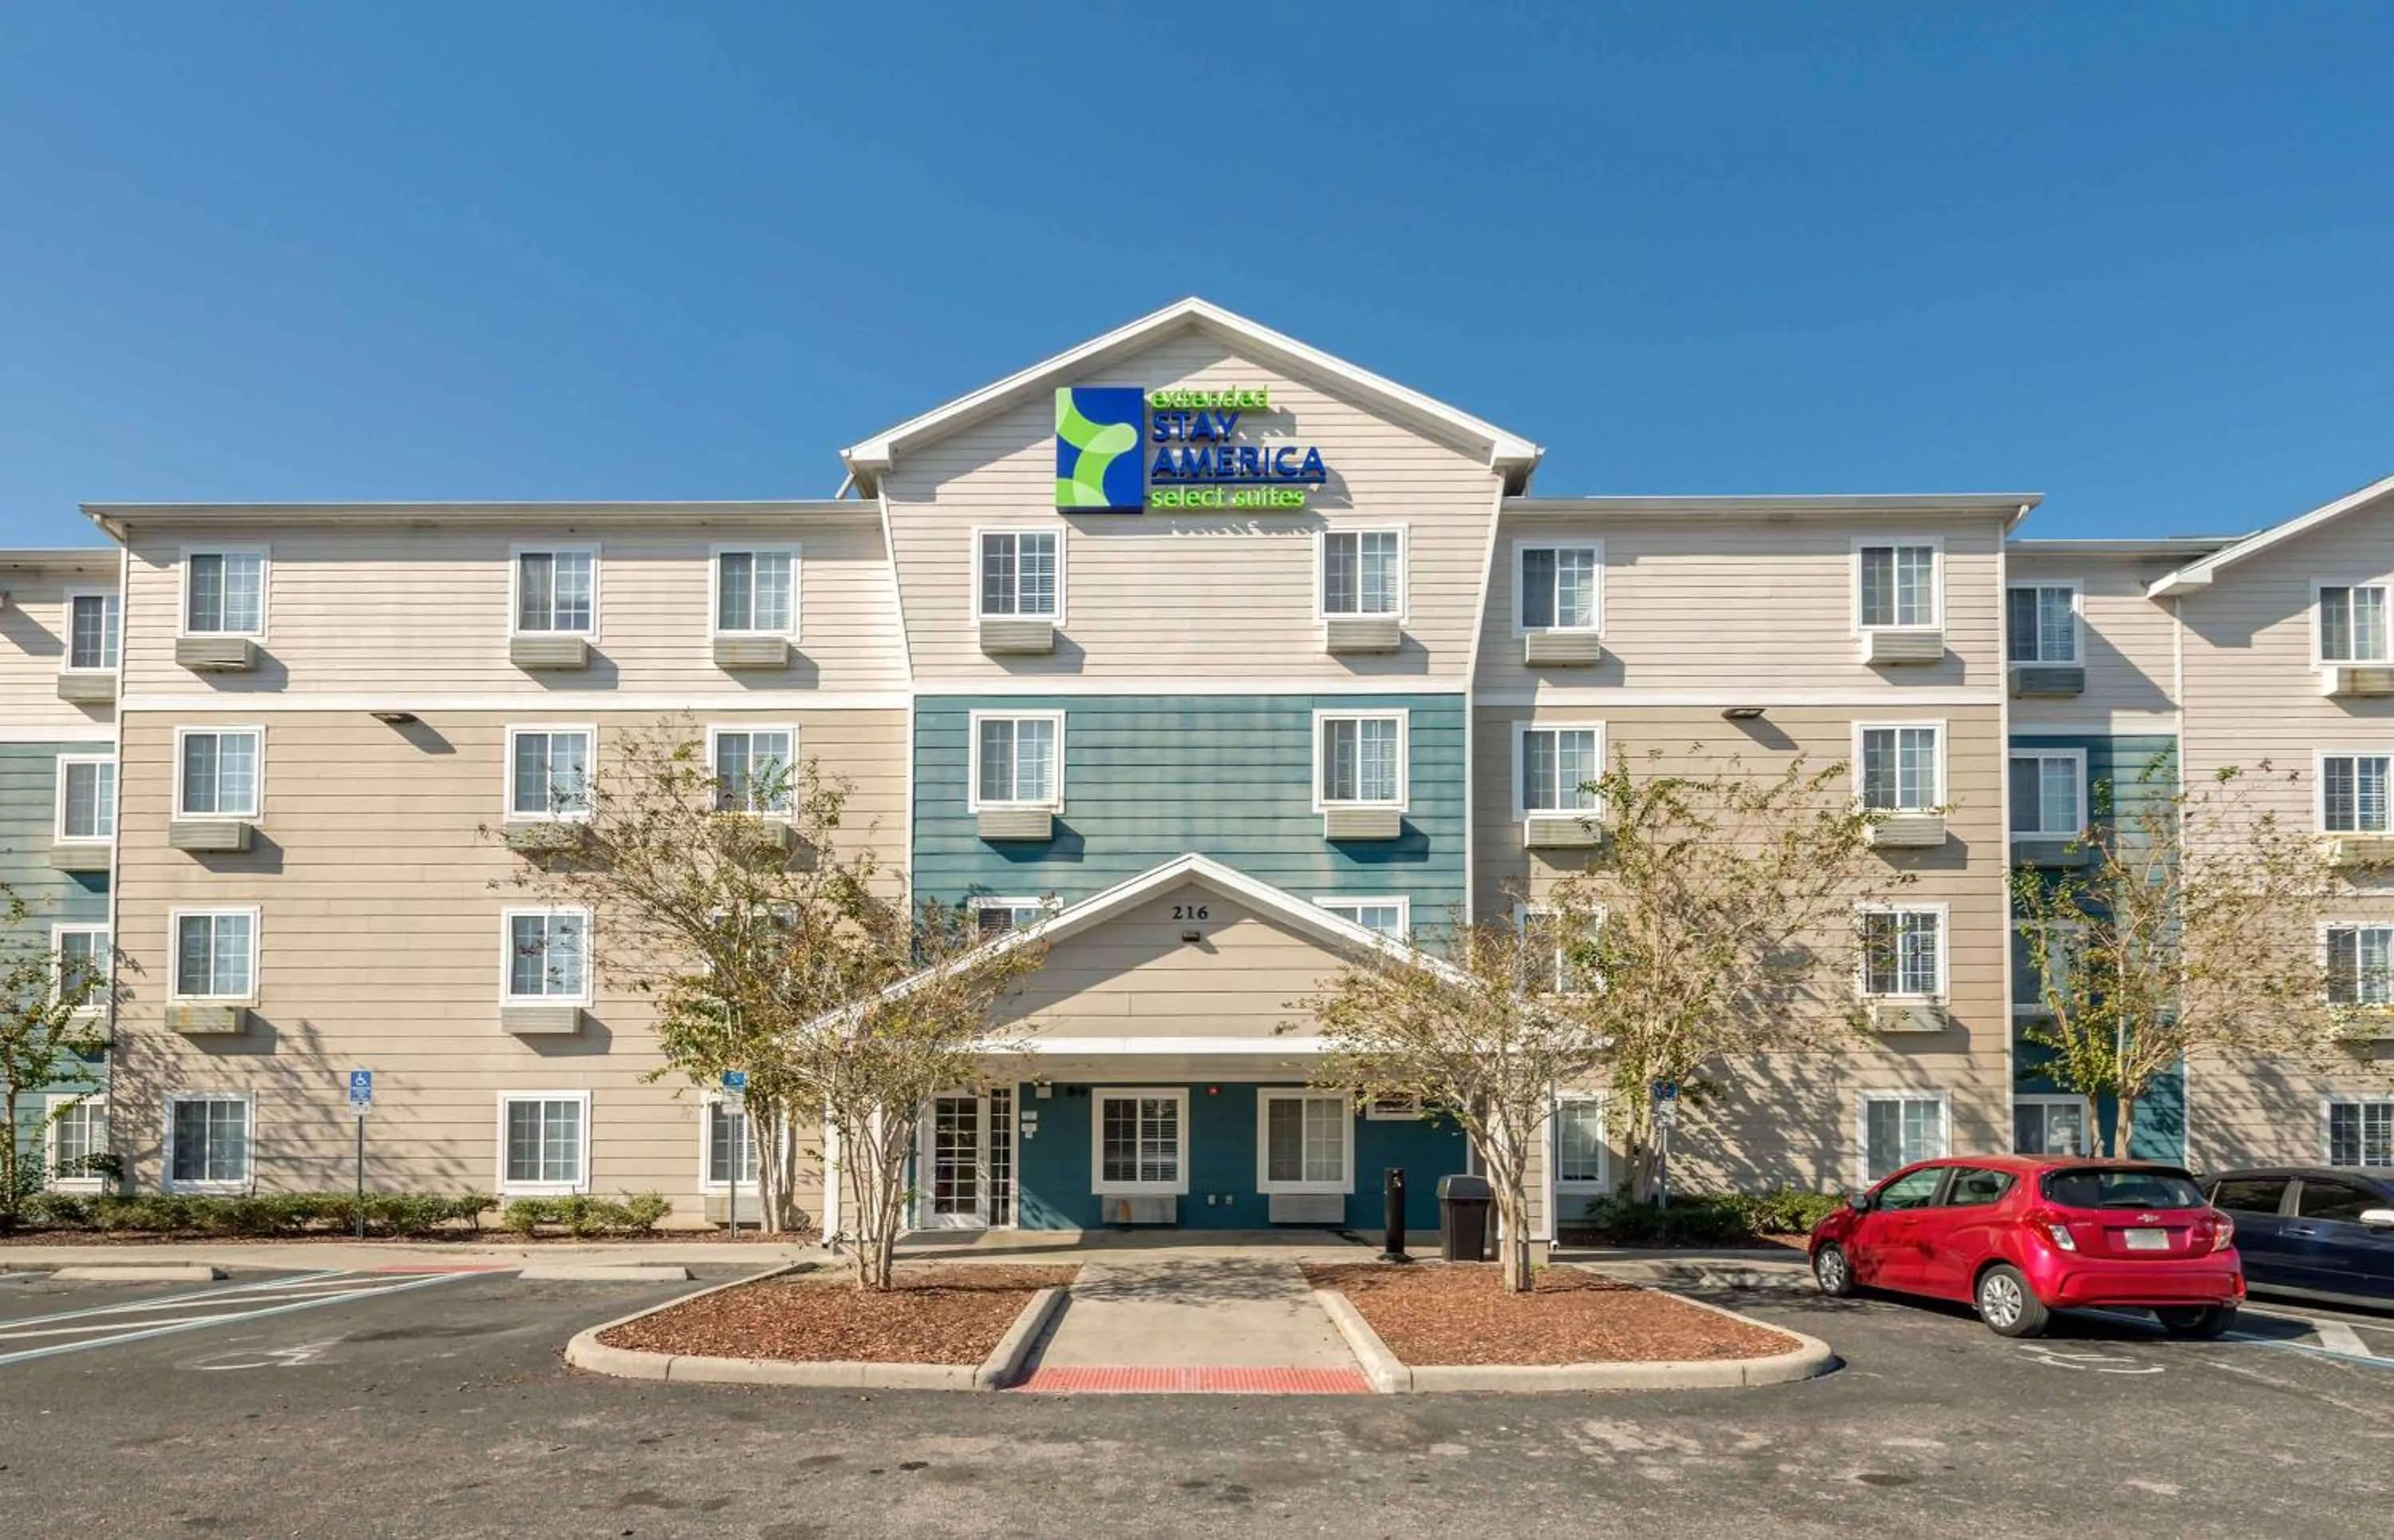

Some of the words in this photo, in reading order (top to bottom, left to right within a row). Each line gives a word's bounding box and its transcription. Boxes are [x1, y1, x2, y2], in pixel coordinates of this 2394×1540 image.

[1152, 384, 1269, 409] extended
[1152, 411, 1240, 442] STAY
[1152, 446, 1326, 477] AMERICA
[1151, 485, 1226, 509] select
[1234, 486, 1306, 509] suites
[1172, 906, 1208, 920] 216
